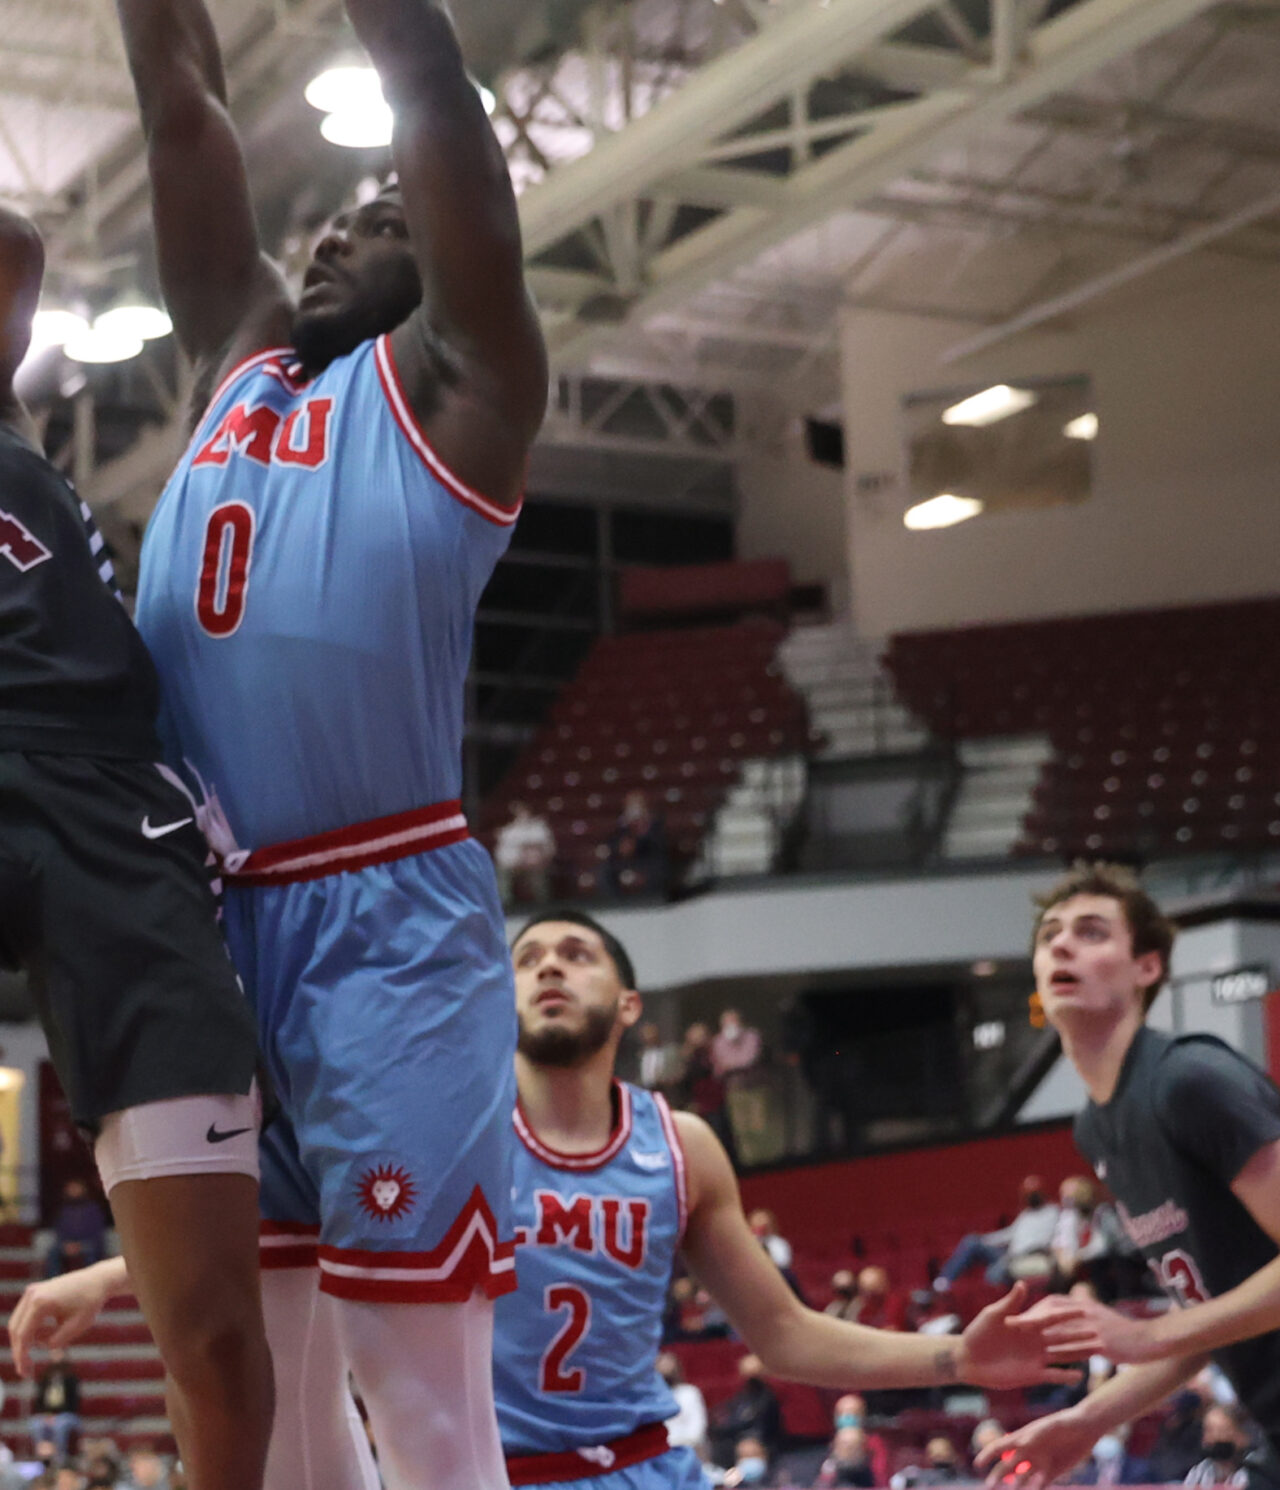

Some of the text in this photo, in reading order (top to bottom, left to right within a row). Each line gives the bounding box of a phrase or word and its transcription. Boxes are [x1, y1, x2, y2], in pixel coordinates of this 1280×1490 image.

[194, 500, 256, 639] 0
[1146, 1247, 1210, 1310] 3
[538, 1281, 592, 1394] 2
